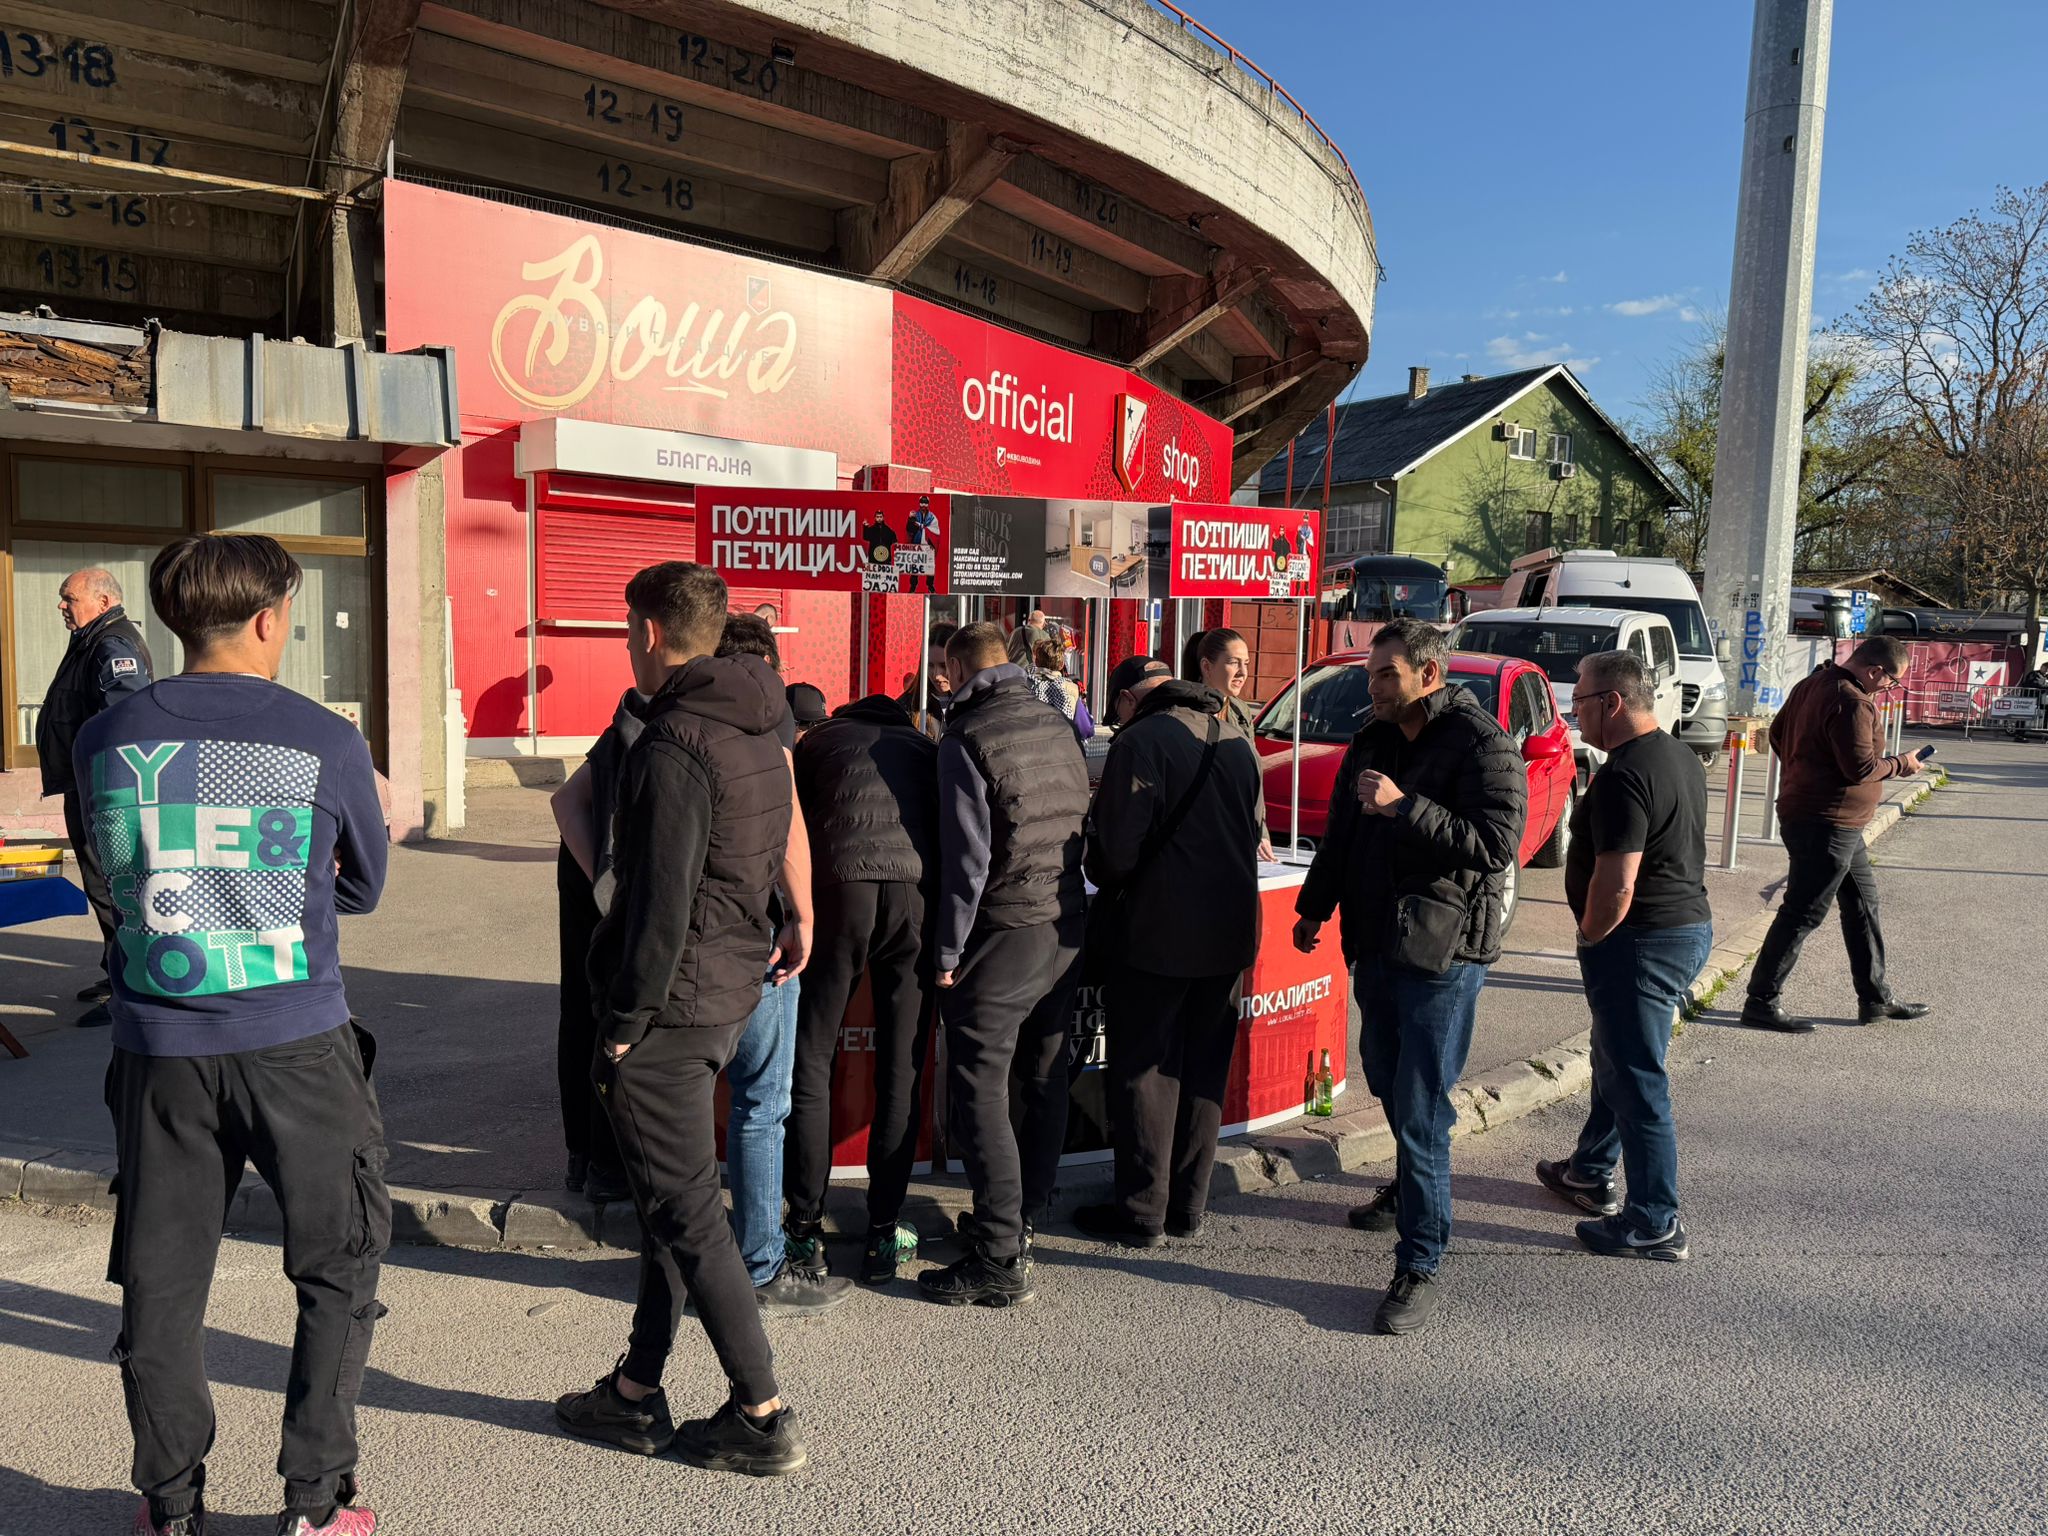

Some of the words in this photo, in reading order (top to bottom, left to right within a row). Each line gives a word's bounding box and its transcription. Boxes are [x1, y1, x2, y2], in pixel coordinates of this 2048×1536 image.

[0, 30, 117, 89] 13-18
[678, 33, 778, 94] 12-20
[584, 83, 684, 142] 12-19
[26, 183, 147, 228] 13-16
[597, 162, 695, 212] 12-18
[1031, 230, 1073, 274] 11-19
[954, 264, 998, 306] 11-18
[963, 371, 1074, 443] official
[656, 449, 752, 476] БЛАГАЈНА
[1163, 436, 1200, 496] shop
[712, 505, 856, 539] ПОТПИШИ
[1182, 520, 1270, 549] ПОТПИШИ
[1855, 592, 1865, 606] P
[1238, 974, 1332, 1020] ЛОКАЛИТЕТ
